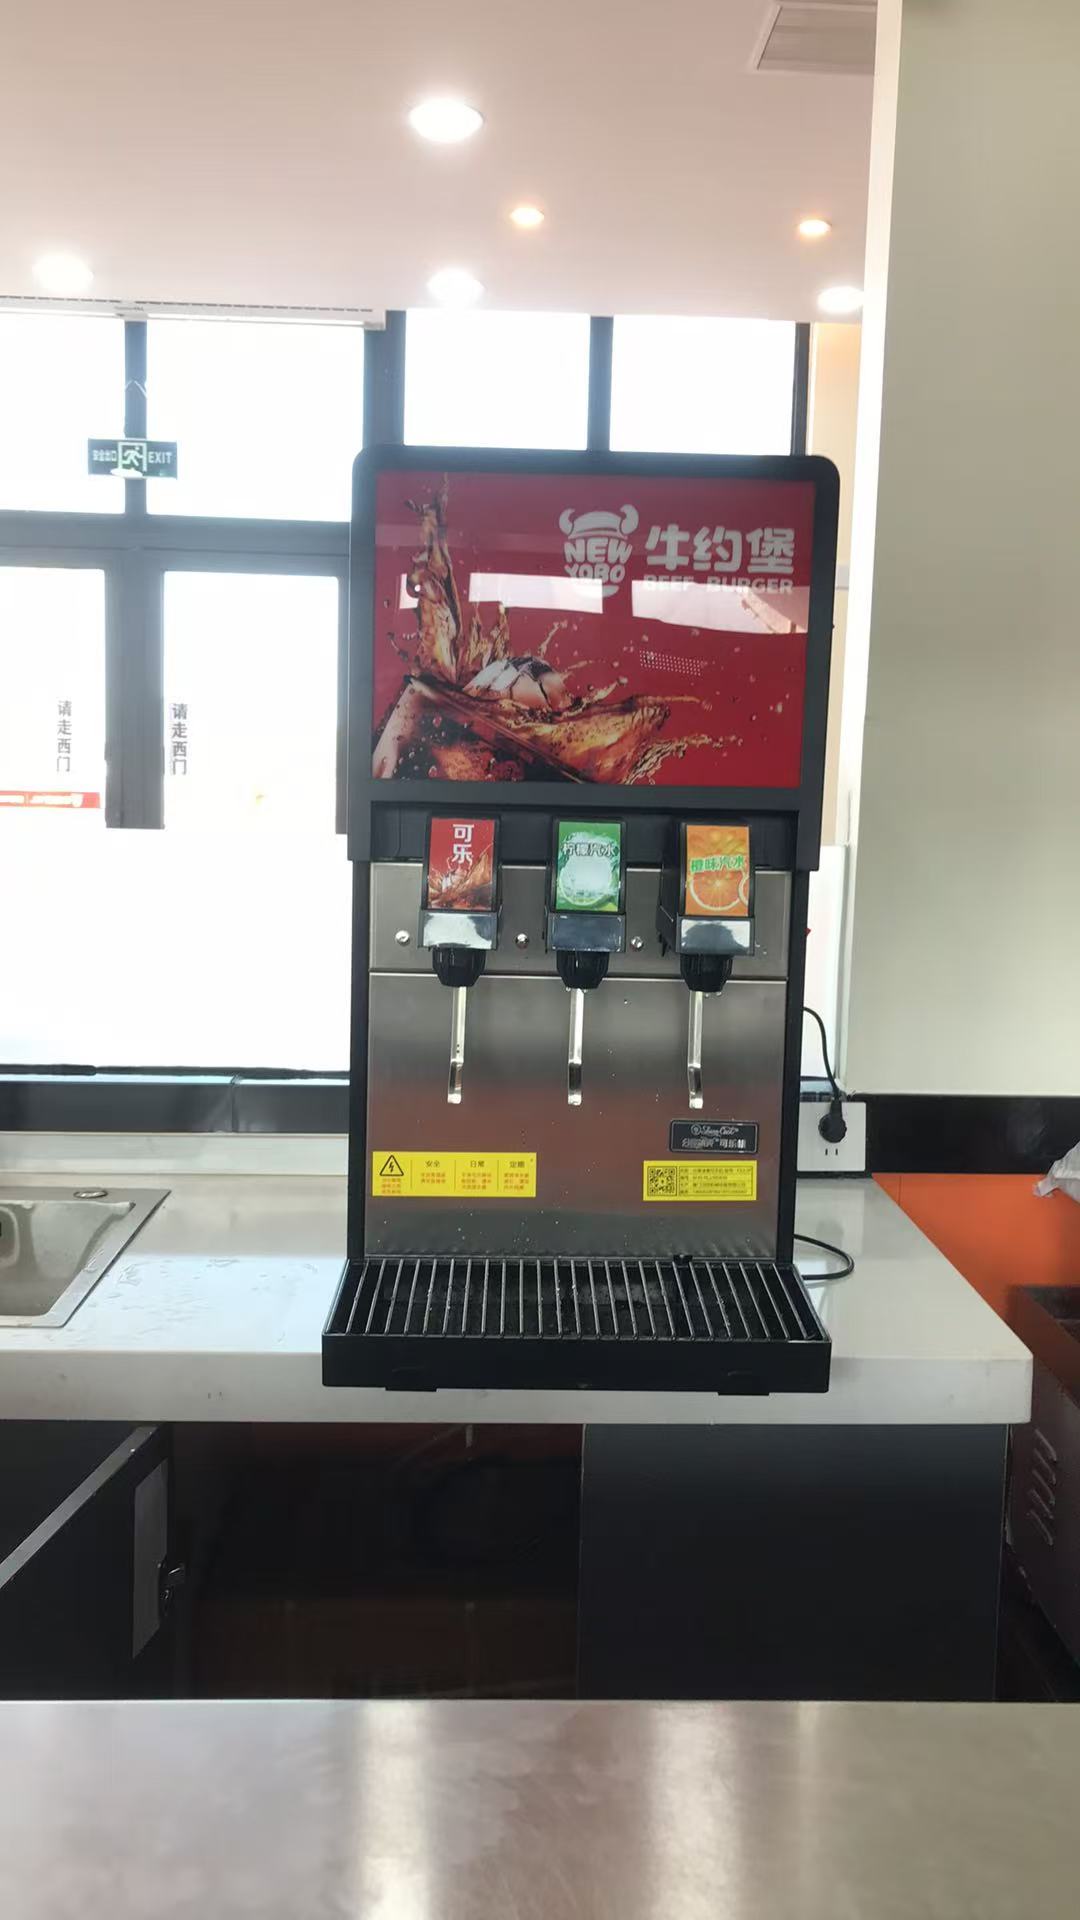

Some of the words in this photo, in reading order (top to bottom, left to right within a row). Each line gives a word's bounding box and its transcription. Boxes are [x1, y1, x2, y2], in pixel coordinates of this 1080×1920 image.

[148, 451, 173, 464] EXIT
[564, 537, 633, 563] NEW
[645, 524, 796, 574] 牛约堡
[564, 562, 626, 583] YOBO
[643, 574, 695, 592] BEEF
[707, 576, 795, 594] BURGER
[57, 700, 72, 773] 请走西门
[171, 703, 188, 775] 请走西门
[451, 823, 475, 866] 可乐
[562, 841, 616, 857] 柠檬汽水
[690, 854, 745, 873] 橙味汽水
